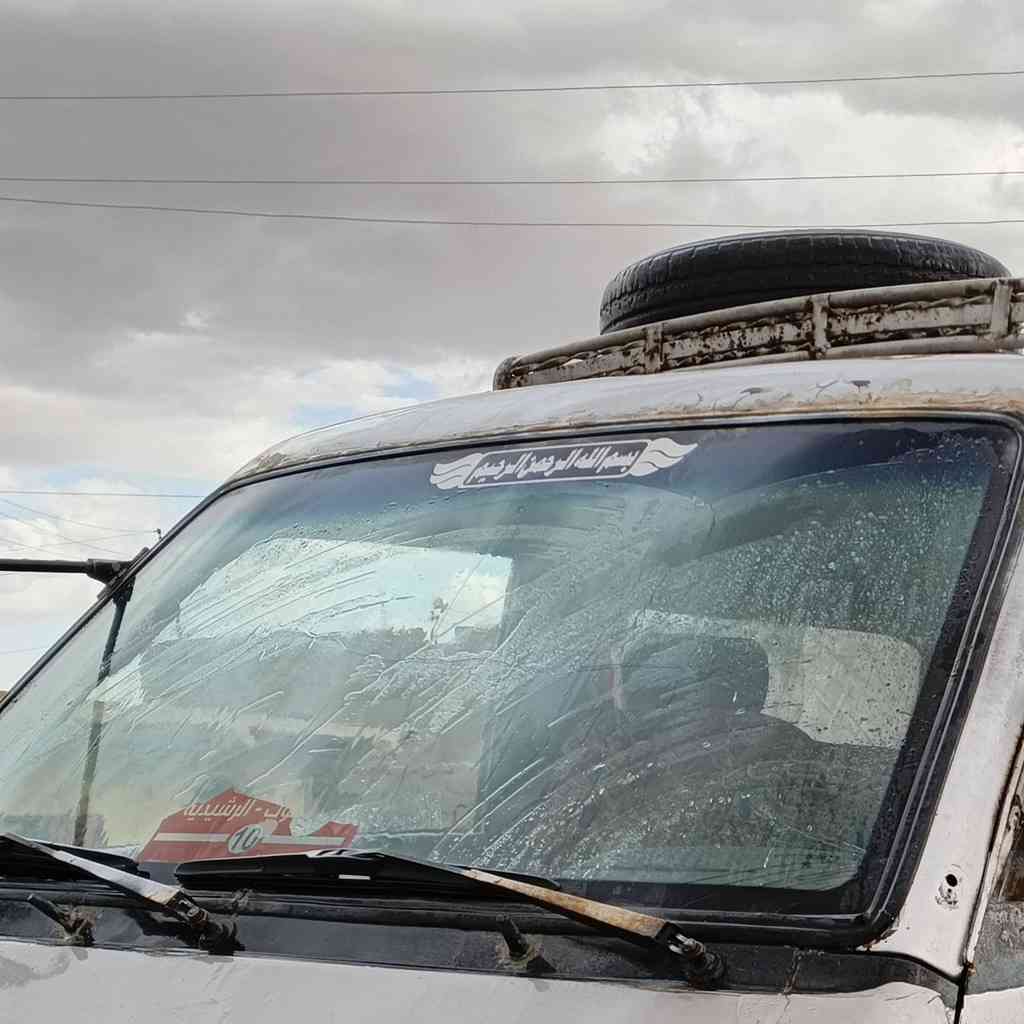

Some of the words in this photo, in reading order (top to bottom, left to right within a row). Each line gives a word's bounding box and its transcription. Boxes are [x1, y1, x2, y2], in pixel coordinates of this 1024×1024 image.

[465, 452, 533, 484] الرحيم
[517, 448, 584, 479] الرحمن
[574, 446, 612, 469] الله
[596, 451, 640, 474] بسم
